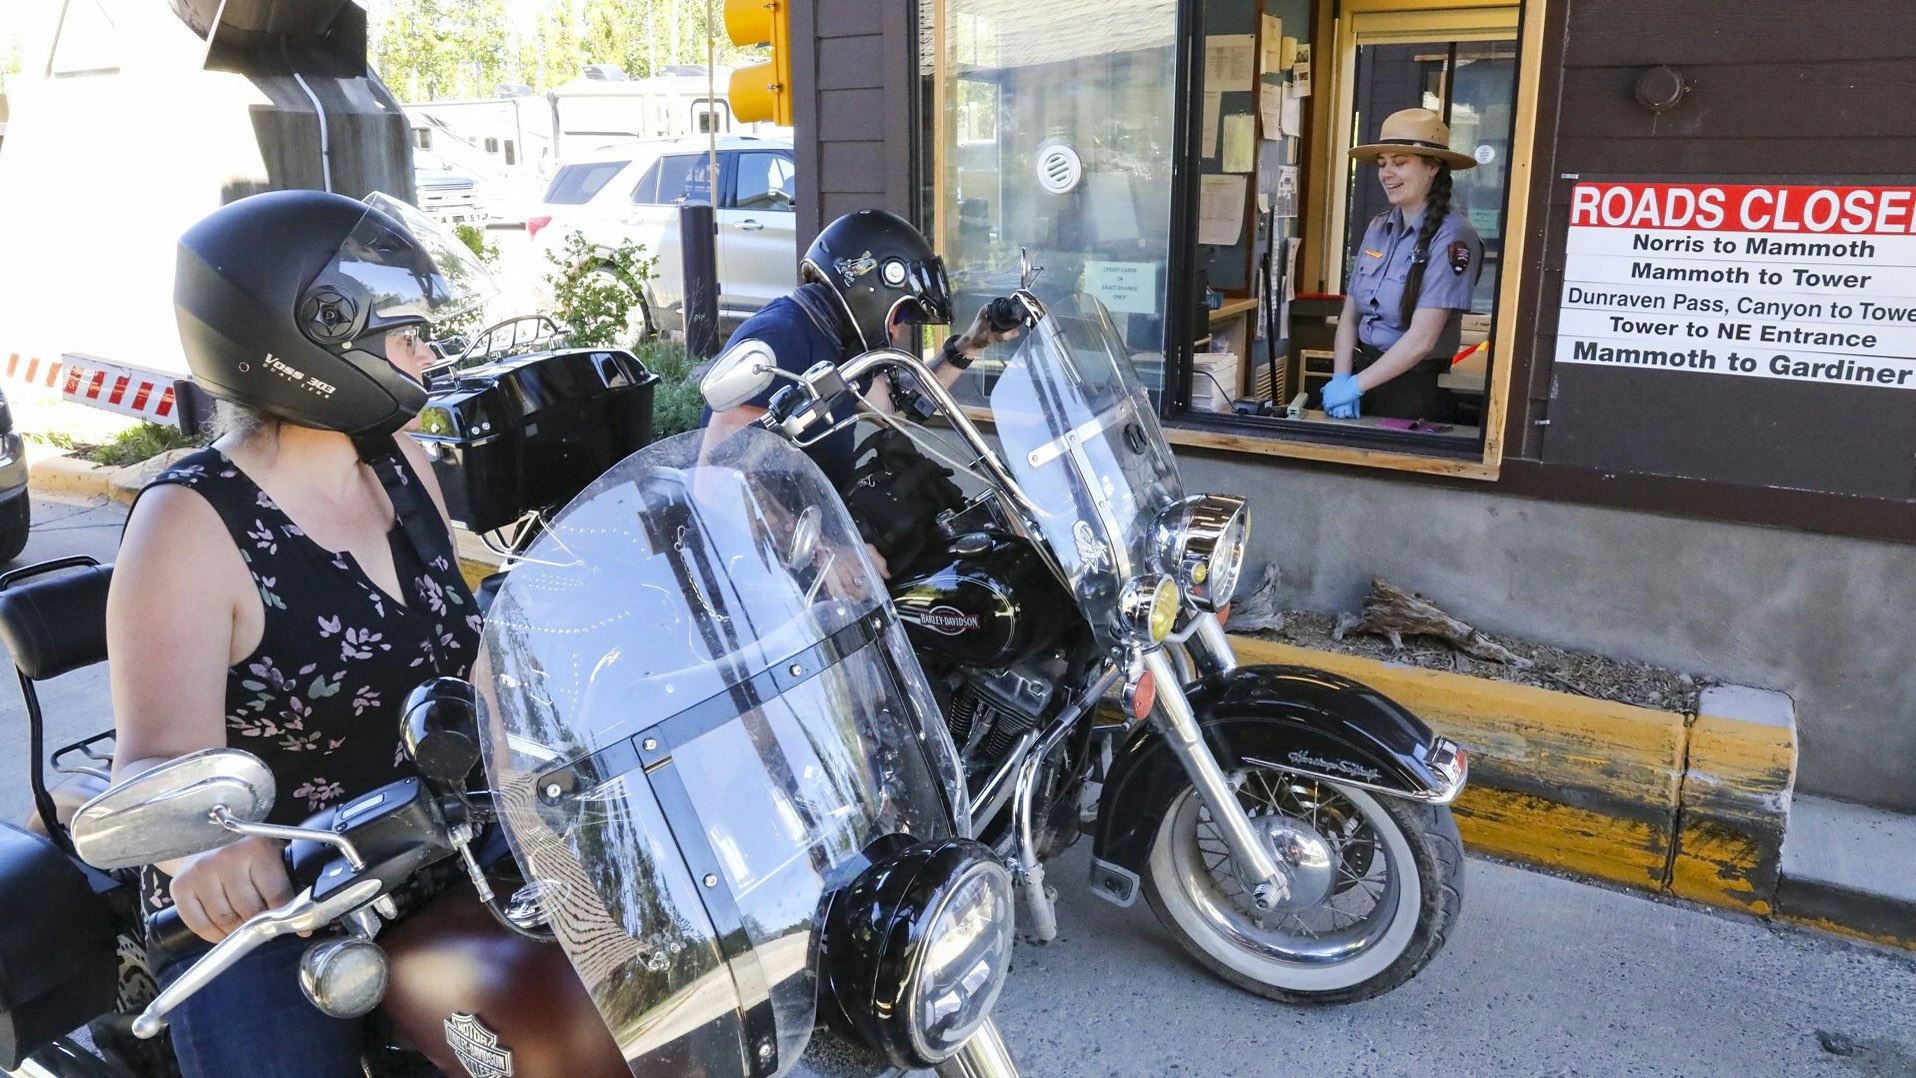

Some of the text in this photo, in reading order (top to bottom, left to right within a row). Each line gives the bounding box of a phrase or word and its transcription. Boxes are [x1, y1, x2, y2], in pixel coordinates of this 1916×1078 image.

[1571, 186, 1916, 233] ROADS CLOSE
[1633, 233, 1875, 258] Norris to Mammoth
[1631, 262, 1872, 288] Mammoth to Tower
[1568, 288, 1666, 309] Dunraven
[1673, 293, 1729, 315] Pass,
[1737, 297, 1822, 321] Canyon
[1830, 302, 1853, 319] to
[1609, 316, 1877, 348] Tower to NE Entrance
[1573, 341, 1914, 385] Mammoth to Gardiner
[307, 377, 336, 394] 303
[920, 613, 977, 627] HARLEY-DAVIDSON
[457, 1022, 488, 1047] MOTOR
